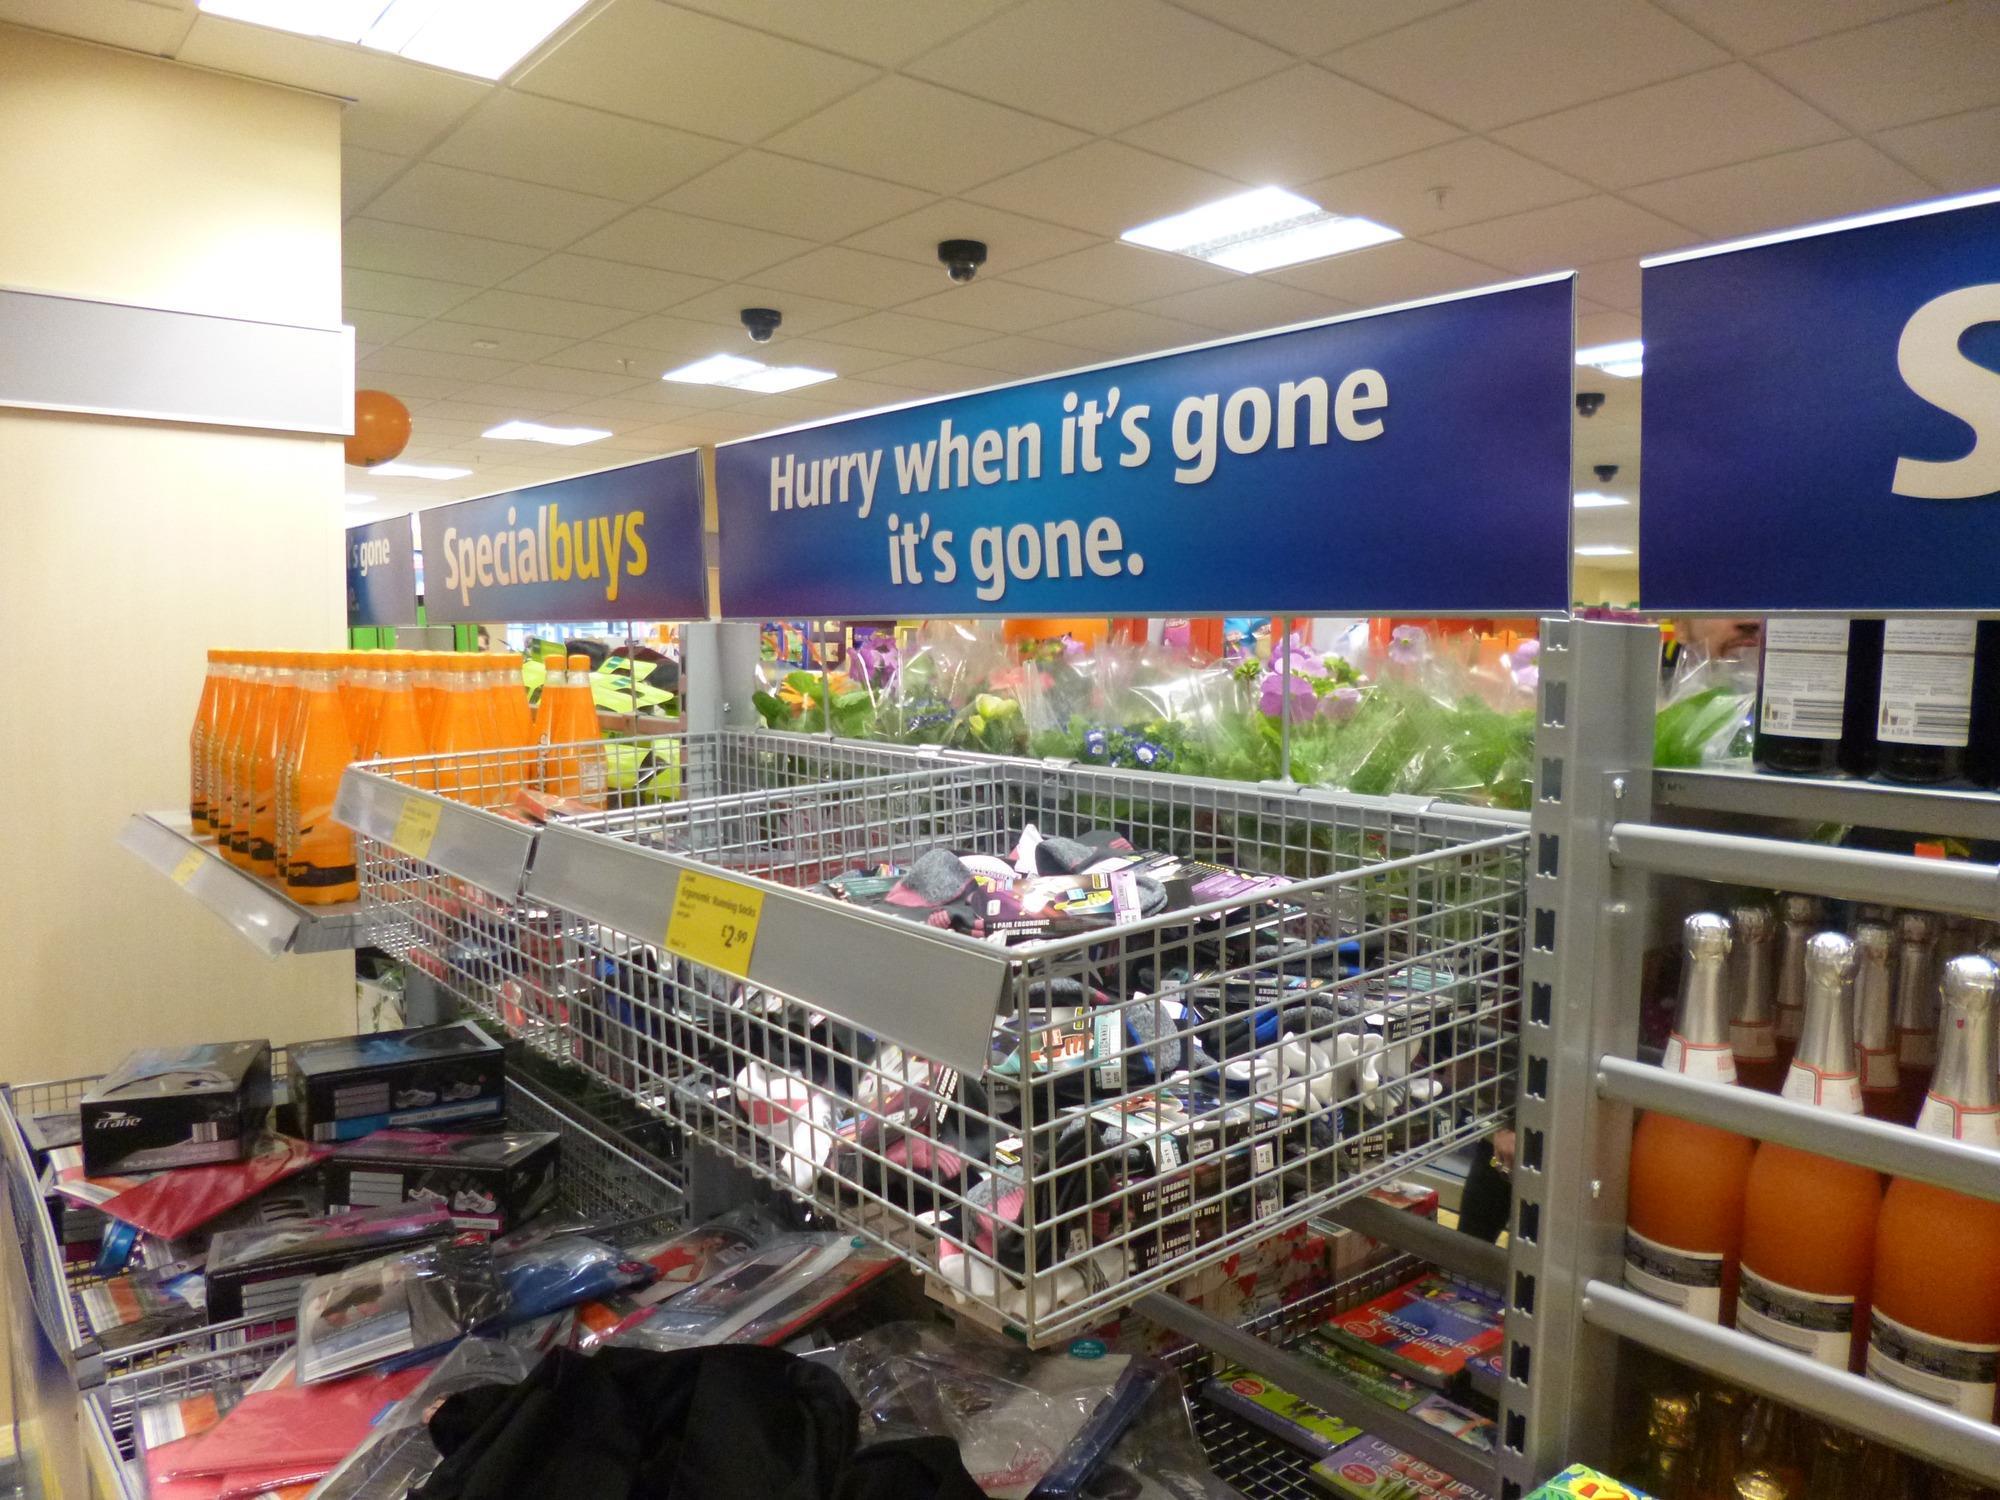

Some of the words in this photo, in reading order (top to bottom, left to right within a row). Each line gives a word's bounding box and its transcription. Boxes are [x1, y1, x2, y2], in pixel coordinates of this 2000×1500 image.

[770, 449, 883, 519] Hurry
[895, 419, 1041, 495] when
[1061, 387, 1150, 475] it's
[1172, 368, 1388, 484] gone
[360, 538, 390, 576] gone
[443, 504, 648, 606] Specialbuys
[889, 513, 956, 585] it's
[971, 517, 1144, 602] gone.
[721, 925, 748, 948] £2.99
[1368, 1306, 1429, 1337] Garden
[1383, 1325, 1452, 1357] Planting
[1429, 1333, 1481, 1355] Small
[1371, 1440, 1444, 1481] Garden
